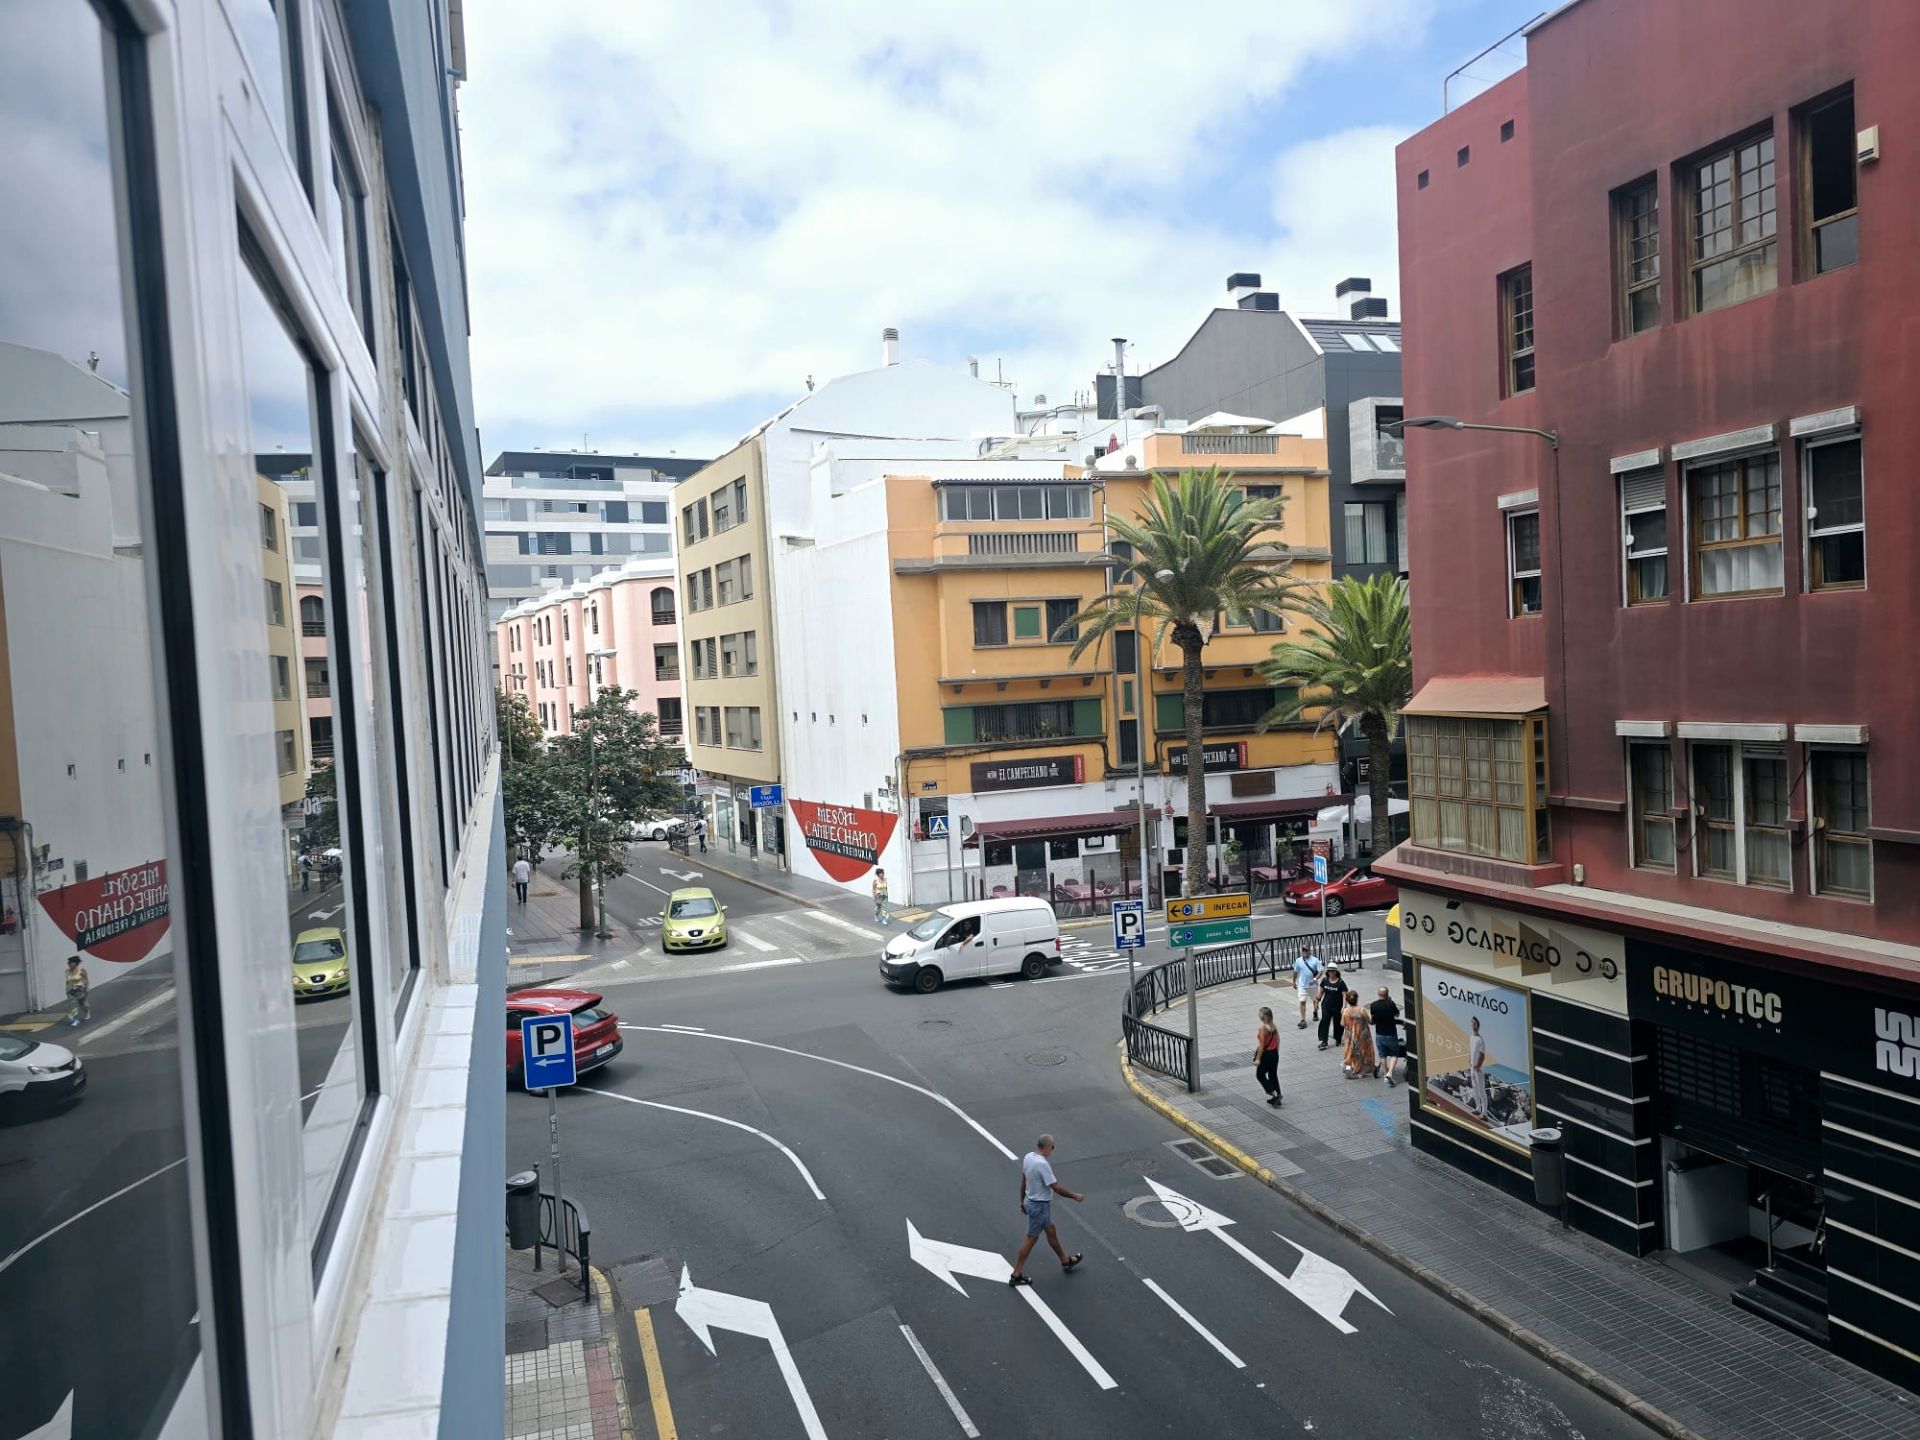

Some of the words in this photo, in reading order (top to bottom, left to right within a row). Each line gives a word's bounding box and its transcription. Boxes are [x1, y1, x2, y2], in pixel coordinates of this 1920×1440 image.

[999, 769, 1006, 780] EL
[1007, 766, 1048, 780] CAMPECHANO
[805, 821, 878, 851] CAMPECHANO
[1213, 902, 1248, 911] INFECAR
[1121, 913, 1137, 934] P
[1466, 926, 1561, 967] CARTAGO
[1450, 987, 1509, 1015] CARTAGO
[1653, 966, 1782, 1024] GRUPOTCC
[536, 1025, 561, 1055] P
